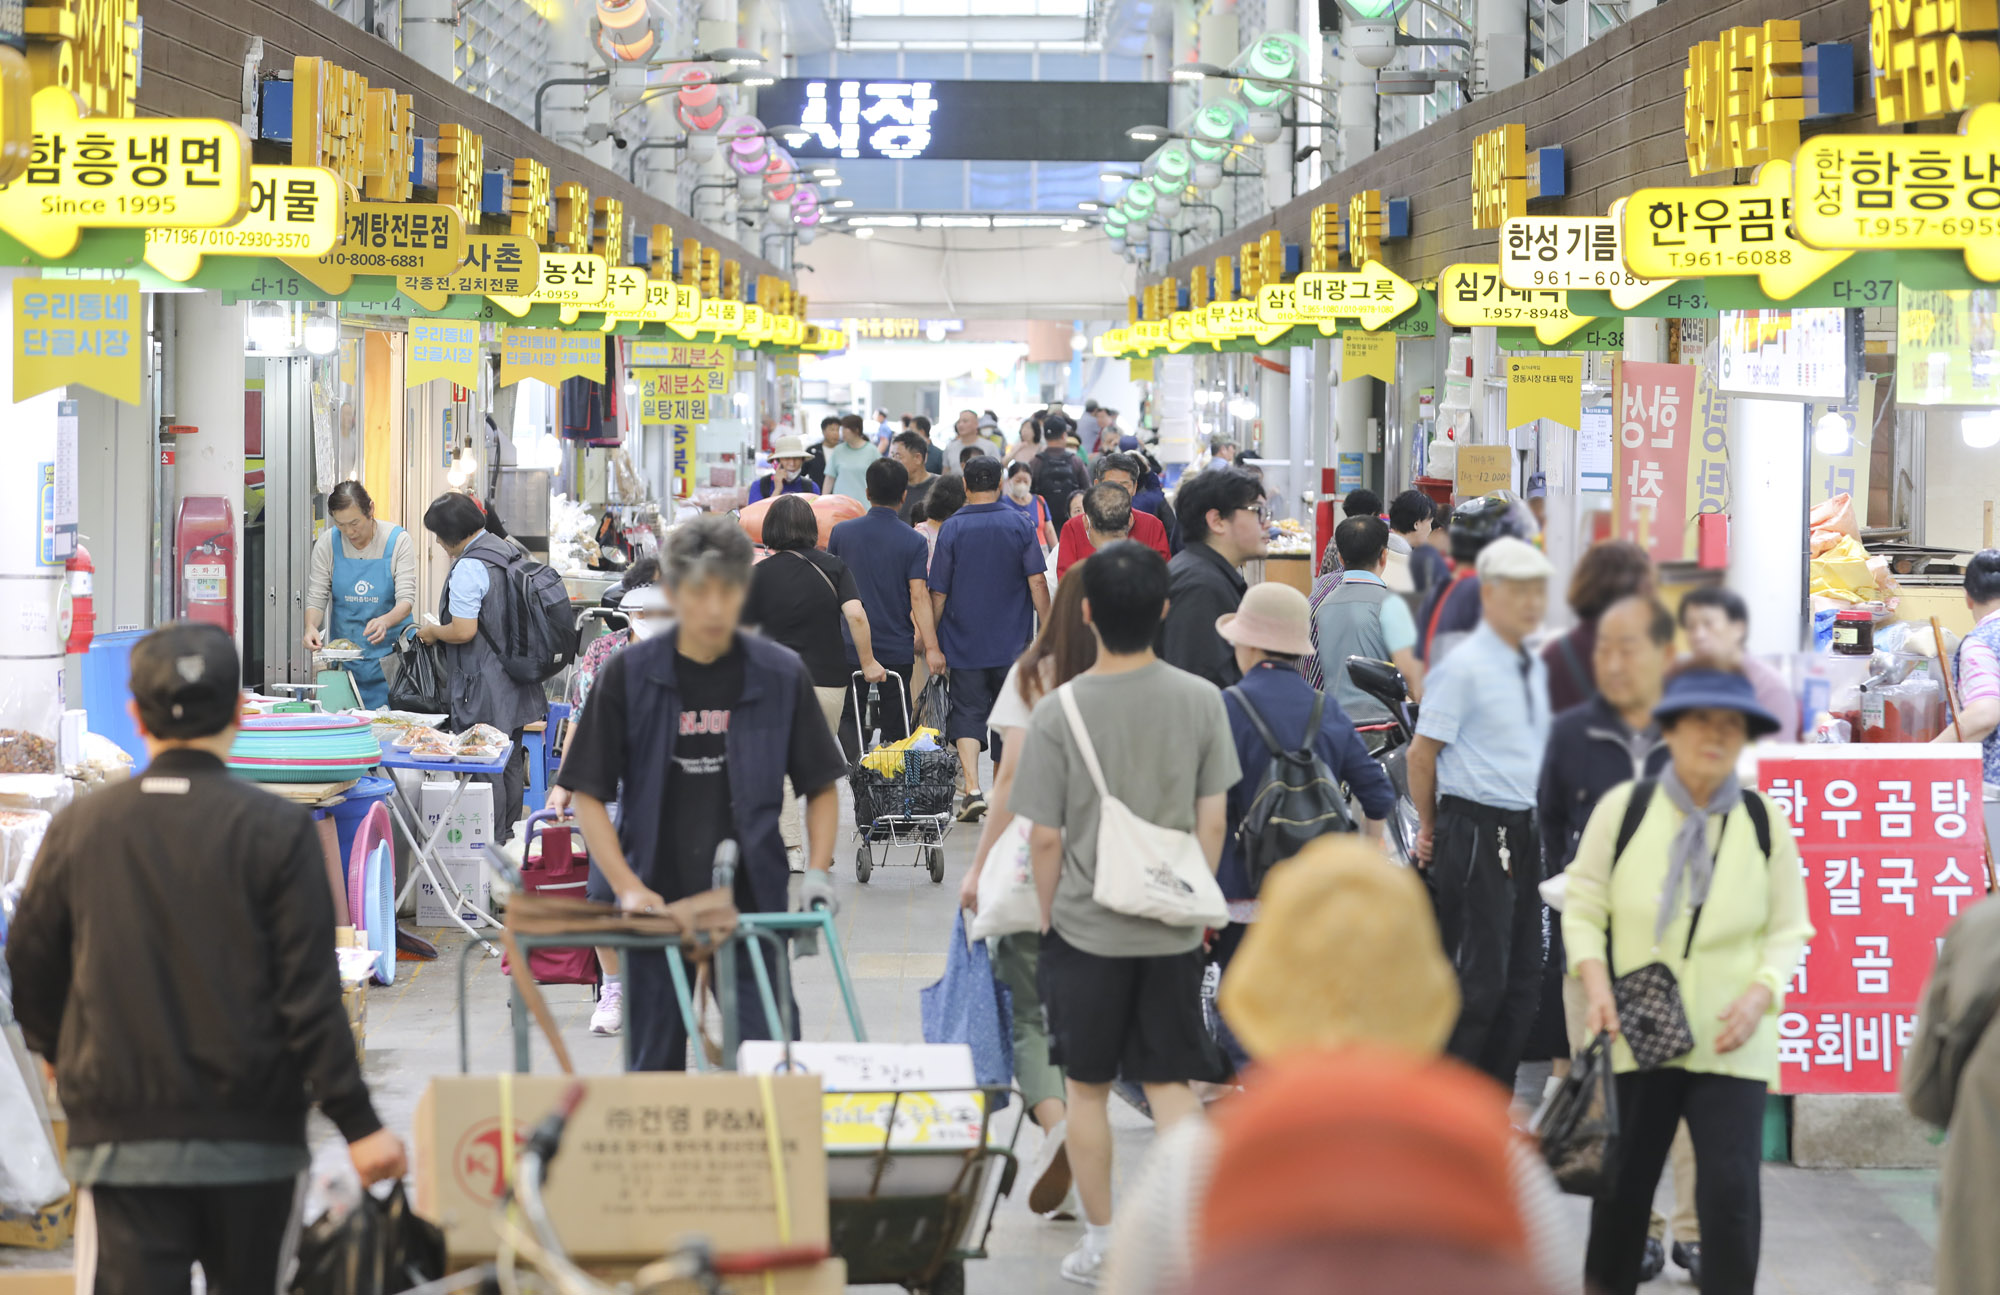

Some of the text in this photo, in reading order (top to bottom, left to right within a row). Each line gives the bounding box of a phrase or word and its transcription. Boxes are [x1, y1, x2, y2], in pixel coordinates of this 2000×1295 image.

[800, 81, 938, 158] 시장
[28, 134, 221, 187] 함흥냉면
[1814, 148, 1845, 216] 한성
[41, 195, 177, 214] Since 1995
[250, 179, 319, 222] 어물
[341, 211, 449, 250] 계탕전문점
[1856, 218, 2000, 237] T.957-695
[1508, 224, 1617, 262] 한성 기름
[318, 253, 424, 267] 010-8008-6881
[463, 242, 523, 272] 사촌
[1669, 250, 1791, 267] T.961-6088
[543, 260, 596, 285] 농산
[251, 277, 299, 296] 다-15
[1303, 279, 1395, 301] 대광그릇
[1833, 279, 1893, 301] 다-37
[23, 293, 129, 321] 우리동네
[706, 303, 736, 320] 식품
[1483, 308, 1569, 319] T.957-8948
[23, 329, 130, 357] 단골시장
[415, 326, 473, 343] 우리동네
[506, 335, 557, 349] 우리동네
[413, 346, 473, 363] 단골시장
[506, 352, 557, 366] 단골시장
[671, 346, 725, 367] 제분소
[658, 374, 706, 394] 제분소
[1512, 374, 1574, 383] 경동시장 대표 떡집
[658, 399, 706, 420] 탕제원
[1799, 856, 1974, 916] 칼국수
